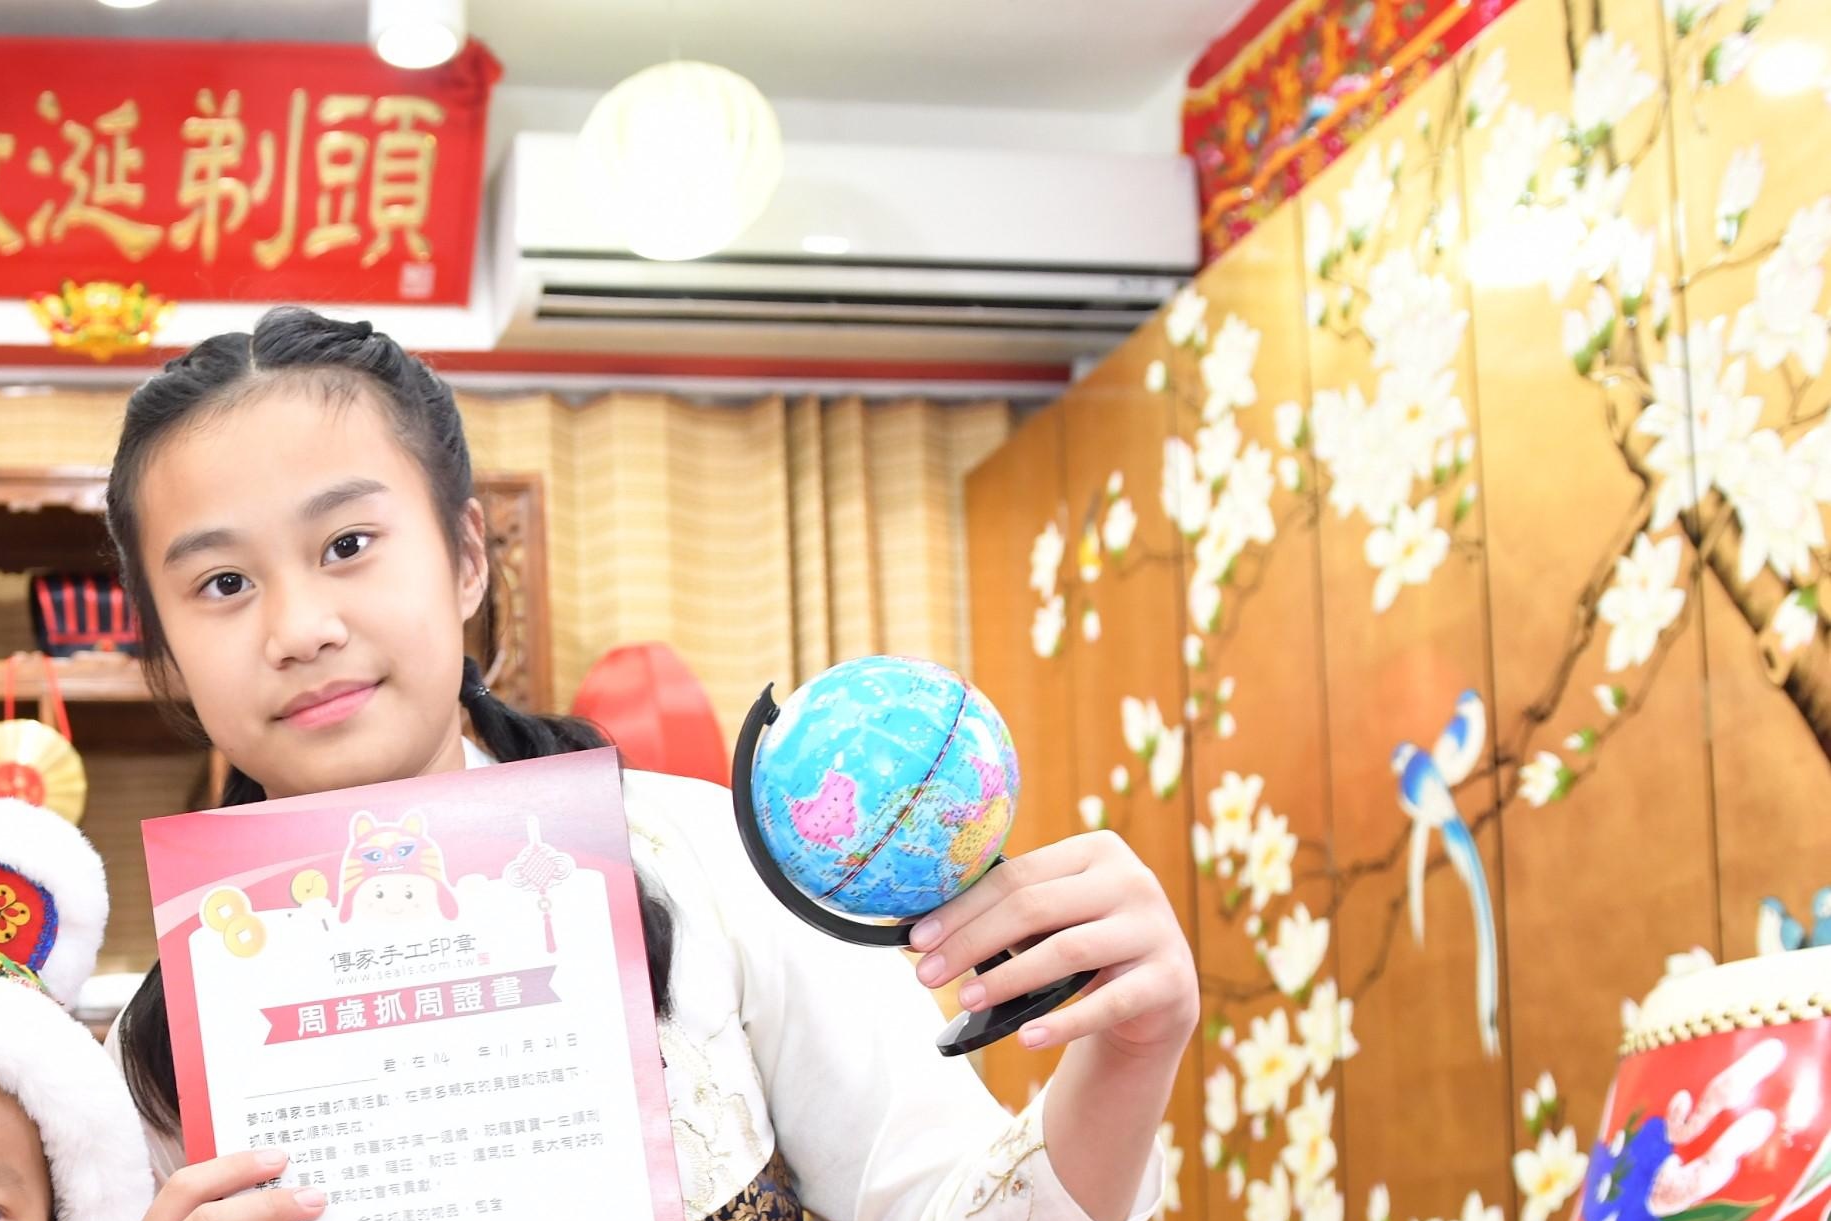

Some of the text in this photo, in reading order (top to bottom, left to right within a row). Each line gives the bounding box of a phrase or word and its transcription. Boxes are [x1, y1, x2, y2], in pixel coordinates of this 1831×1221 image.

[329, 933, 476, 973] 傳家手工印章
[334, 957, 475, 984] www.seals.com.tw
[297, 976, 521, 1034] 周歲抓周證書
